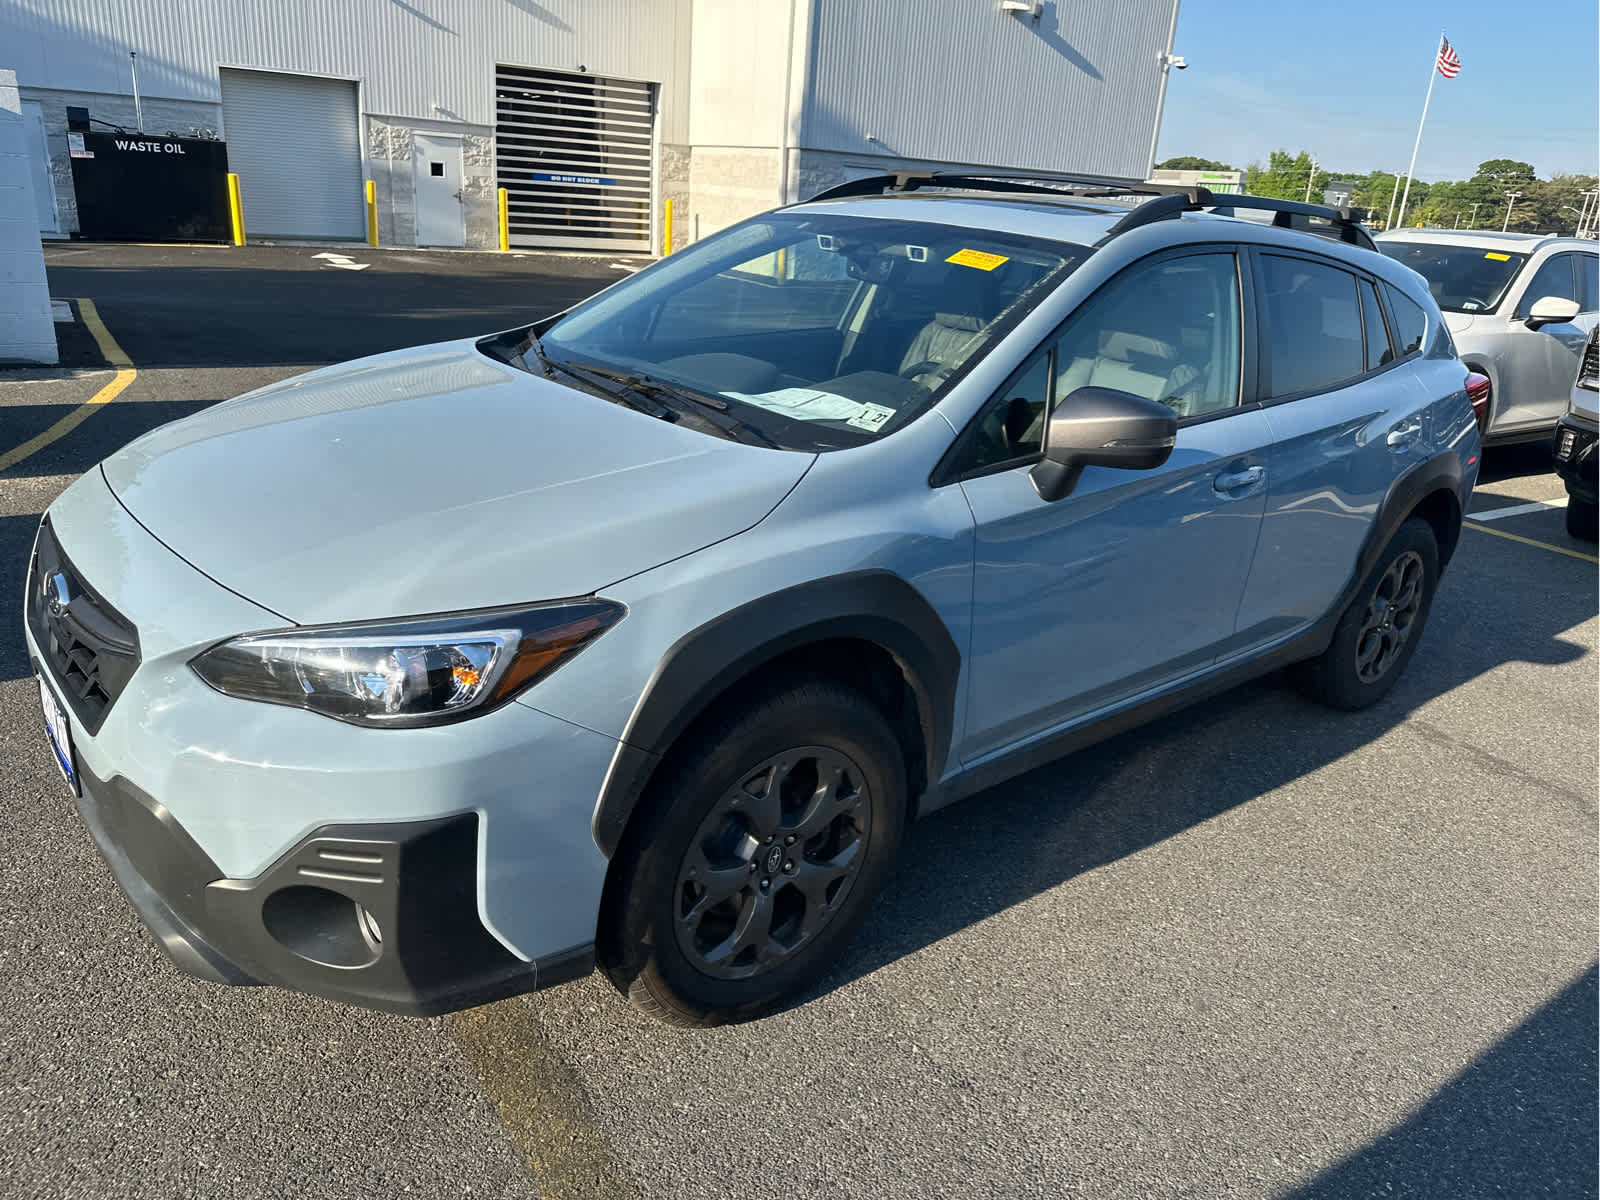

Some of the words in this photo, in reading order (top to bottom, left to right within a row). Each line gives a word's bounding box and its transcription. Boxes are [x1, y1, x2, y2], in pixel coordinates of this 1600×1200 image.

[115, 140, 161, 153] WASTE
[164, 143, 186, 154] OIL
[871, 413, 888, 424] 27
